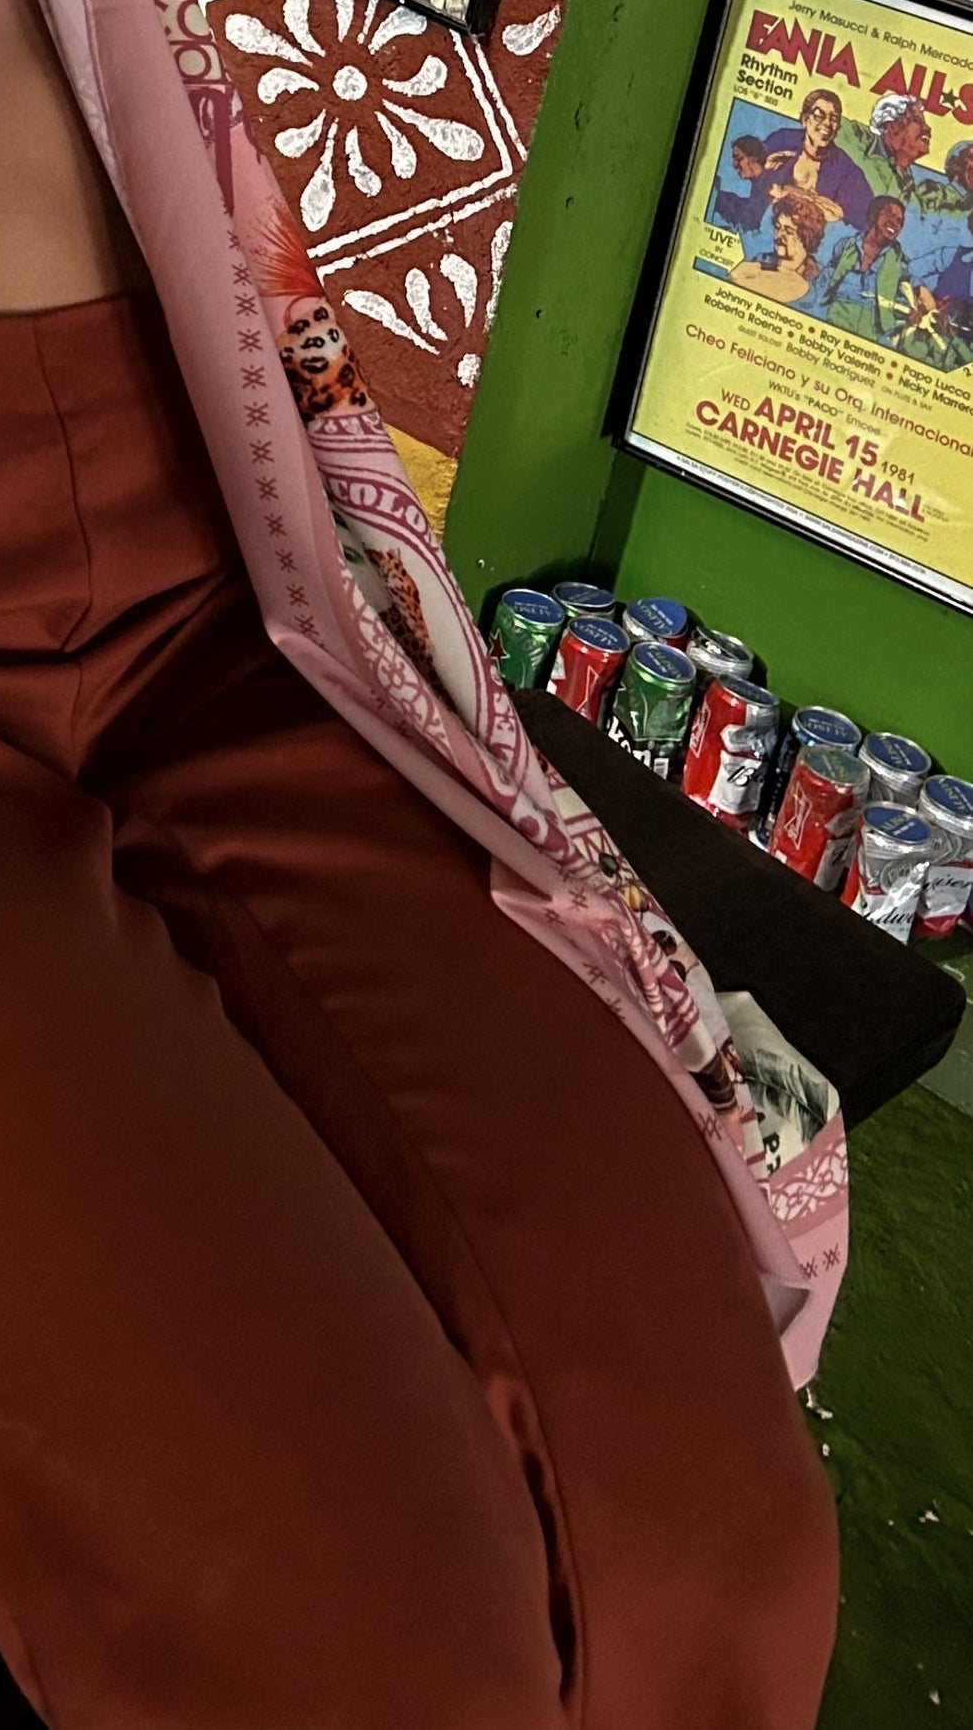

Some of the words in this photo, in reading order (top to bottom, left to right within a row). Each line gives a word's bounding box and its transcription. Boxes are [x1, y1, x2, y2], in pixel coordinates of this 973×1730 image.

[739, 53, 799, 85] Rhythm
[745, 9, 861, 89] FANIA
[869, 57, 954, 118] ALL
[788, 0, 817, 19] Jerry
[819, 9, 869, 35] Masucci
[870, 27, 880, 39] &
[882, 31, 917, 52] Ralph
[920, 44, 973, 71] Mercado
[736, 69, 794, 100] Section
[704, 226, 741, 249] "LIVE"
[685, 323, 726, 351] Cheo
[729, 342, 796, 381] Feliciano
[813, 380, 831, 395] su
[715, 287, 753, 310] Johnny
[755, 302, 804, 331] Pacheco
[820, 330, 841, 348] Ray
[843, 339, 886, 365] Barretto
[903, 364, 933, 385] Papo
[935, 378, 971, 401] Lucca
[786, 342, 821, 365] Bobby
[821, 358, 877, 390] Rodriguez
[799, 333, 834, 358] Bobby
[836, 348, 881, 378] Valentin
[898, 376, 930, 397] Nicky
[932, 389, 973, 417] Marrero
[695, 400, 844, 484] CARNEGIE
[851, 467, 925, 523] HALL
[720, 387, 751, 411] WED
[753, 395, 835, 450] APRIL
[845, 434, 880, 467] 15
[881, 461, 915, 485] 1981
